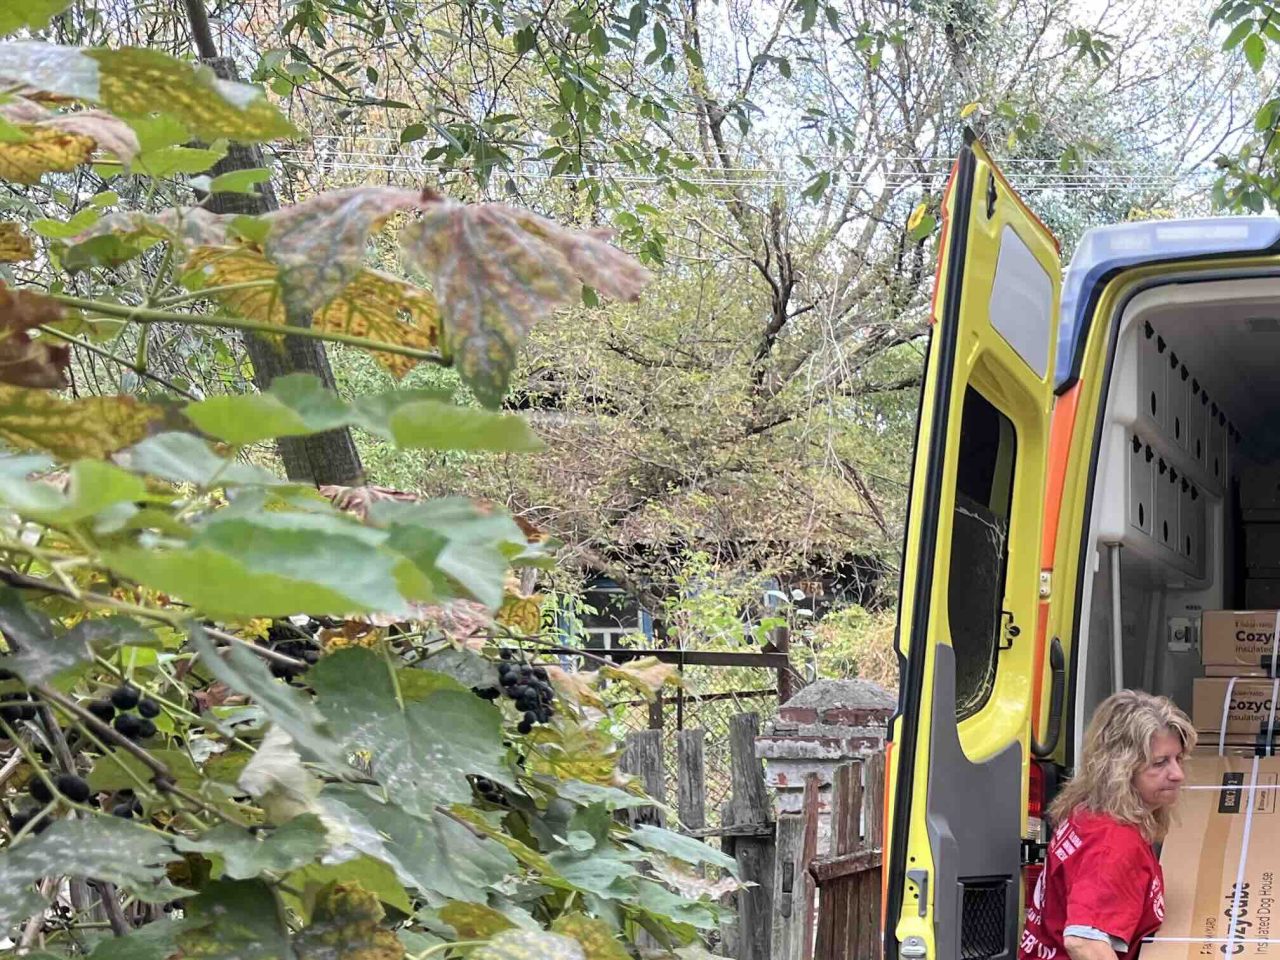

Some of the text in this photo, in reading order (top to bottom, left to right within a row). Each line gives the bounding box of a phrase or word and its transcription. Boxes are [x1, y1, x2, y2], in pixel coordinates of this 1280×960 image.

[1254, 872, 1275, 954] Inslated Dog House
